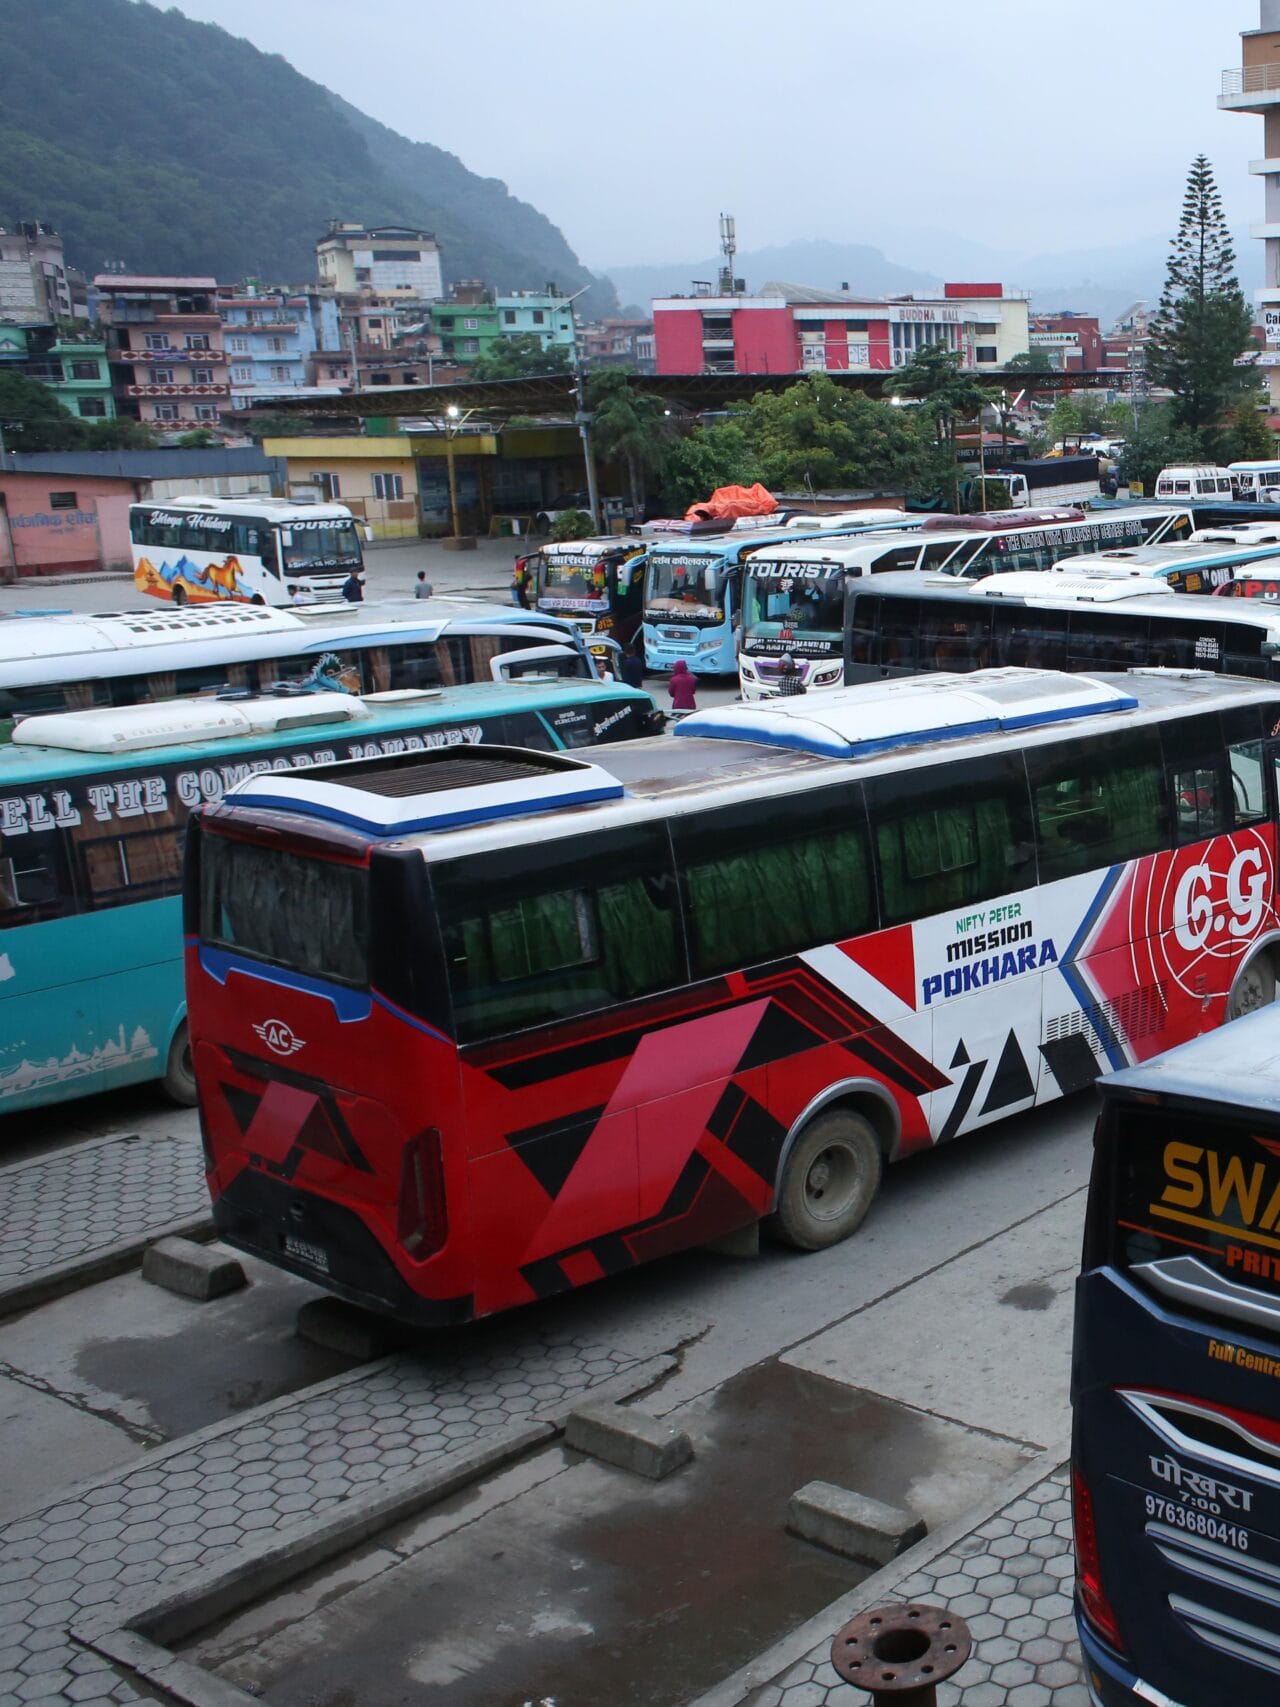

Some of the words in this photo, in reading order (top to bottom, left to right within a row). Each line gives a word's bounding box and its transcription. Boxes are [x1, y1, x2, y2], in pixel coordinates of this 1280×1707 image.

[900, 309, 935, 321] BUDDHA
[942, 310, 960, 322] MALL
[286, 519, 352, 531] TOURIST
[88, 776, 168, 822] THE
[176, 748, 337, 807] COMFORT
[348, 724, 484, 757] JOURNEY
[956, 908, 987, 934] NIFTY
[989, 902, 1022, 926] PETER
[922, 938, 1058, 1005] POKHARA
[268, 1027, 290, 1048] AC
[1208, 1340, 1233, 1361] Full
[1149, 1454, 1254, 1513] पोखरा
[1177, 1490, 1221, 1516] 7:00
[1145, 1495, 1248, 1550] 9763680416
